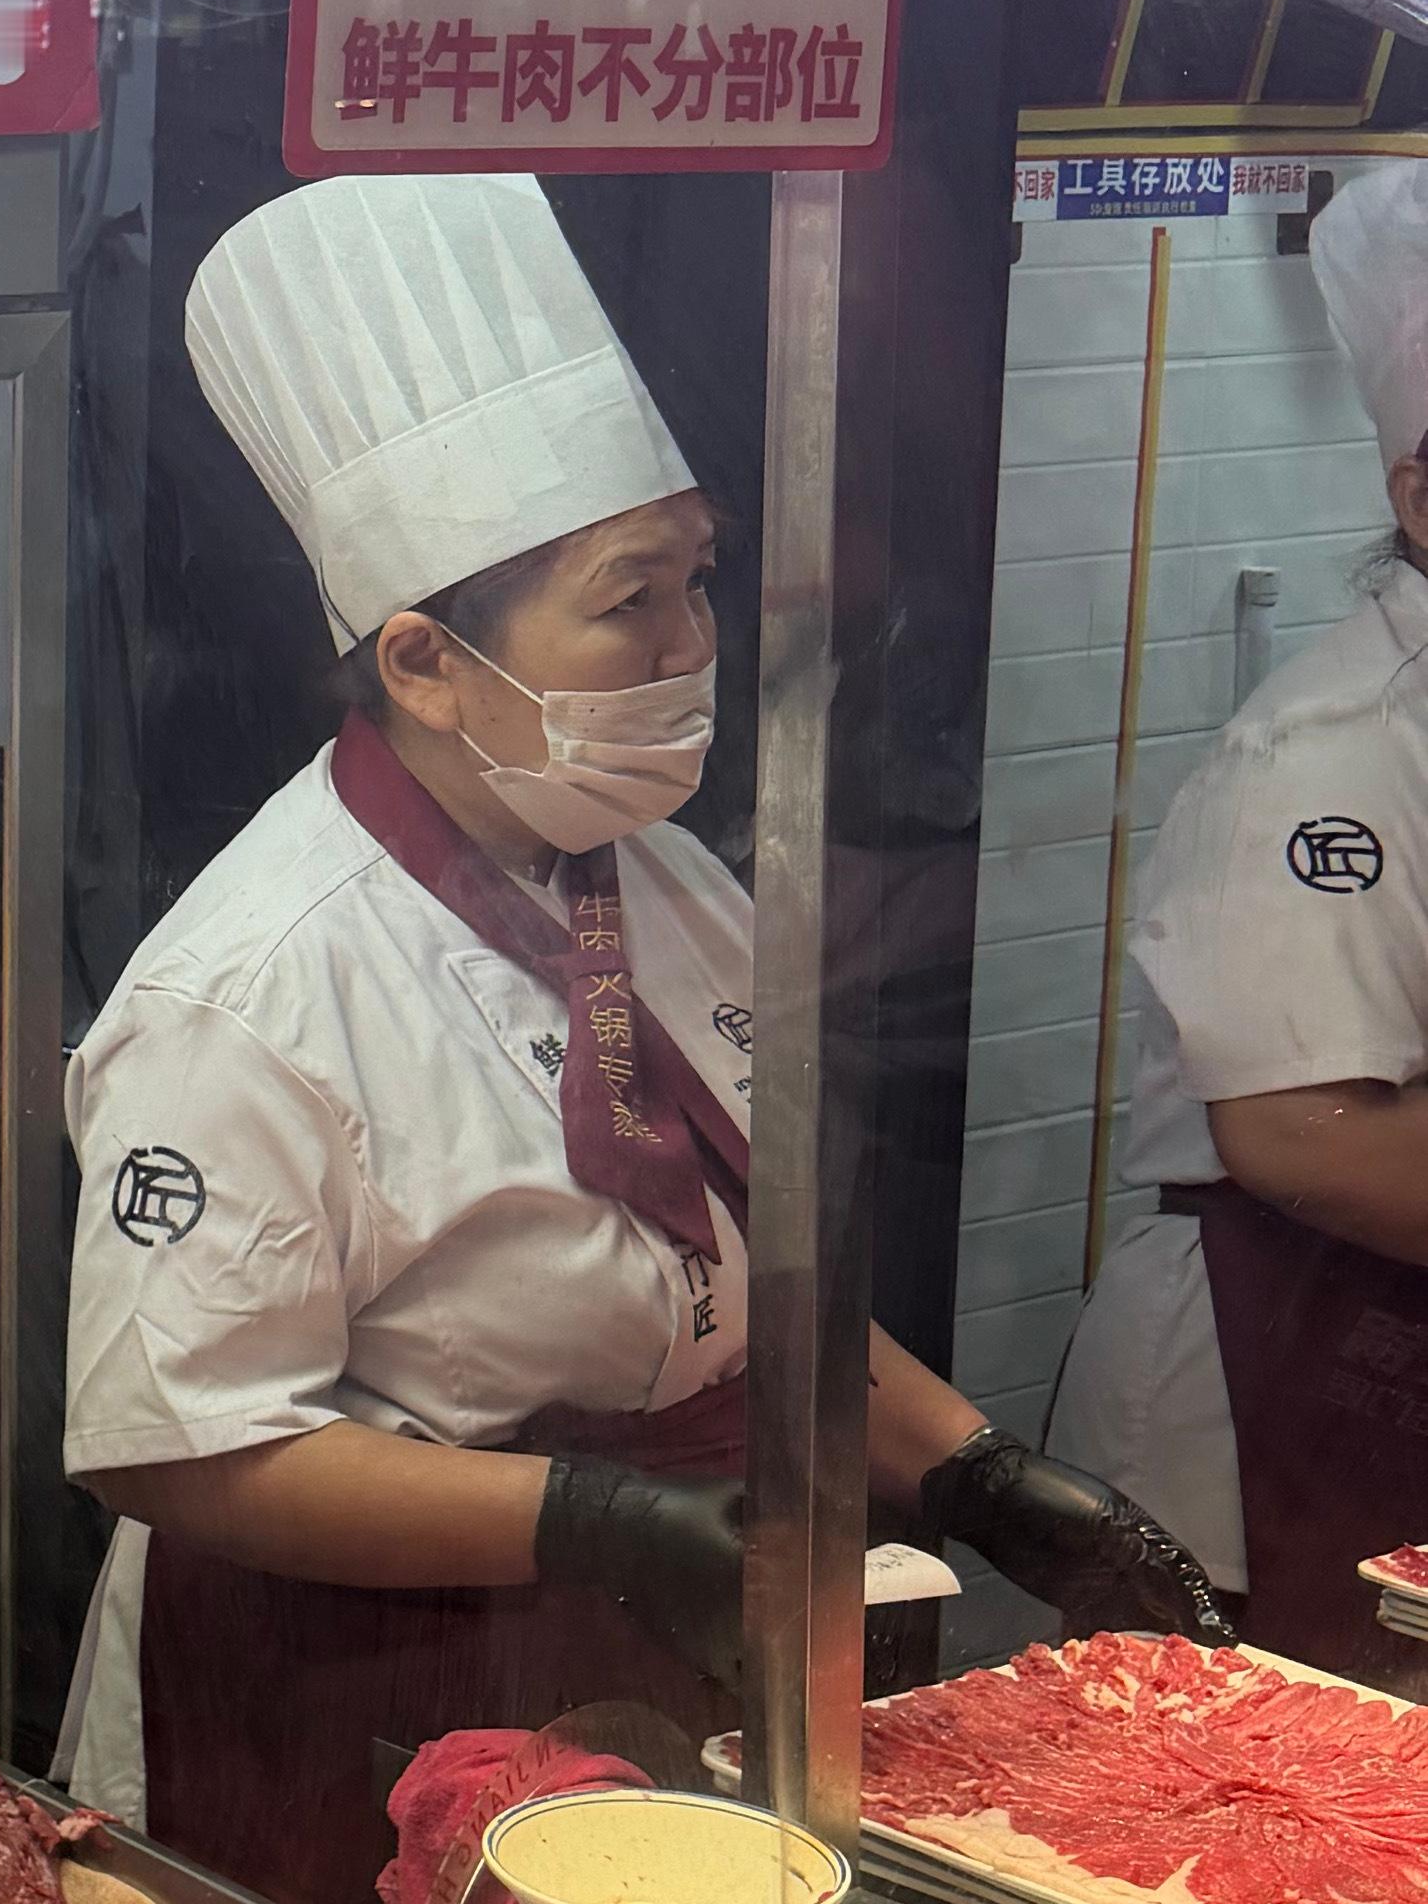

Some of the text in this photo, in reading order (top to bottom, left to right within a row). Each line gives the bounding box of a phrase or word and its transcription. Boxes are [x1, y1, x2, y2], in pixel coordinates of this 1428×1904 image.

[340, 16, 863, 124] 鲜牛肉不分部位
[1063, 157, 1225, 197] 工具存放处
